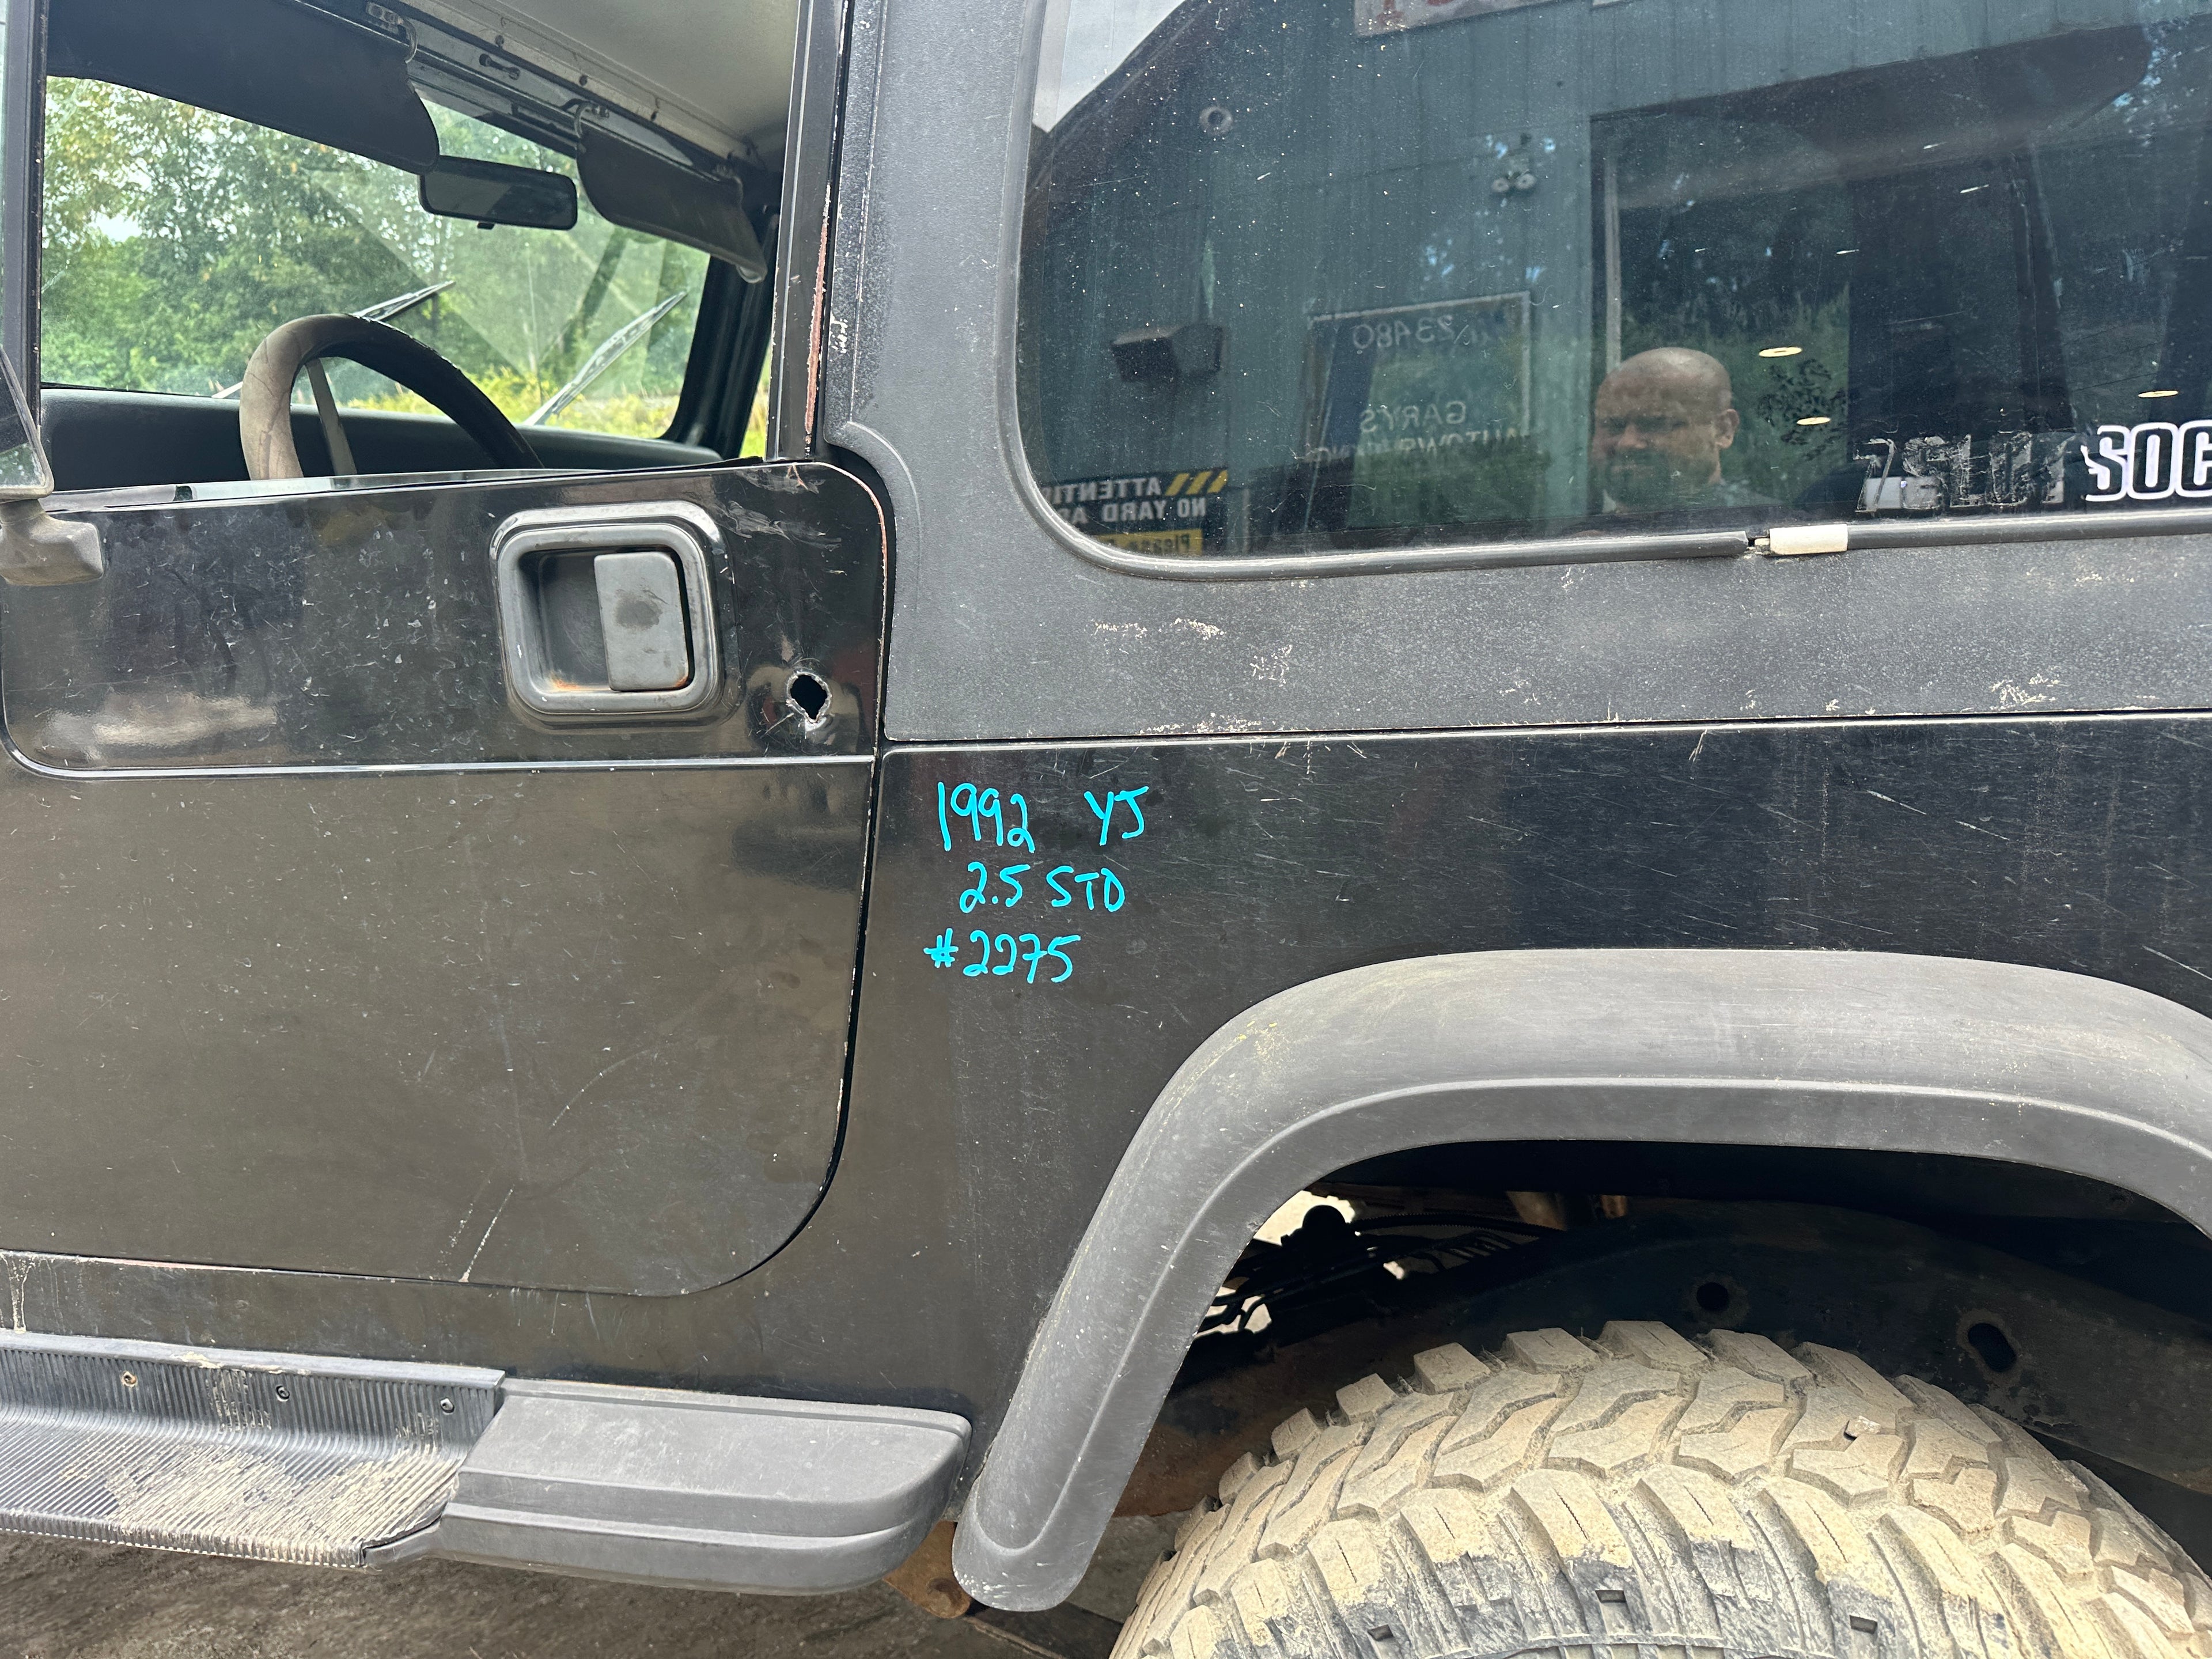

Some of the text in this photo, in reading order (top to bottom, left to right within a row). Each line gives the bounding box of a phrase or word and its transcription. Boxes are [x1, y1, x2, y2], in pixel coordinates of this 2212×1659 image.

[937, 782, 1148, 853] 1992 YJ
[959, 861, 1126, 913] 2.5 STD
[924, 929, 1080, 983] #2275
